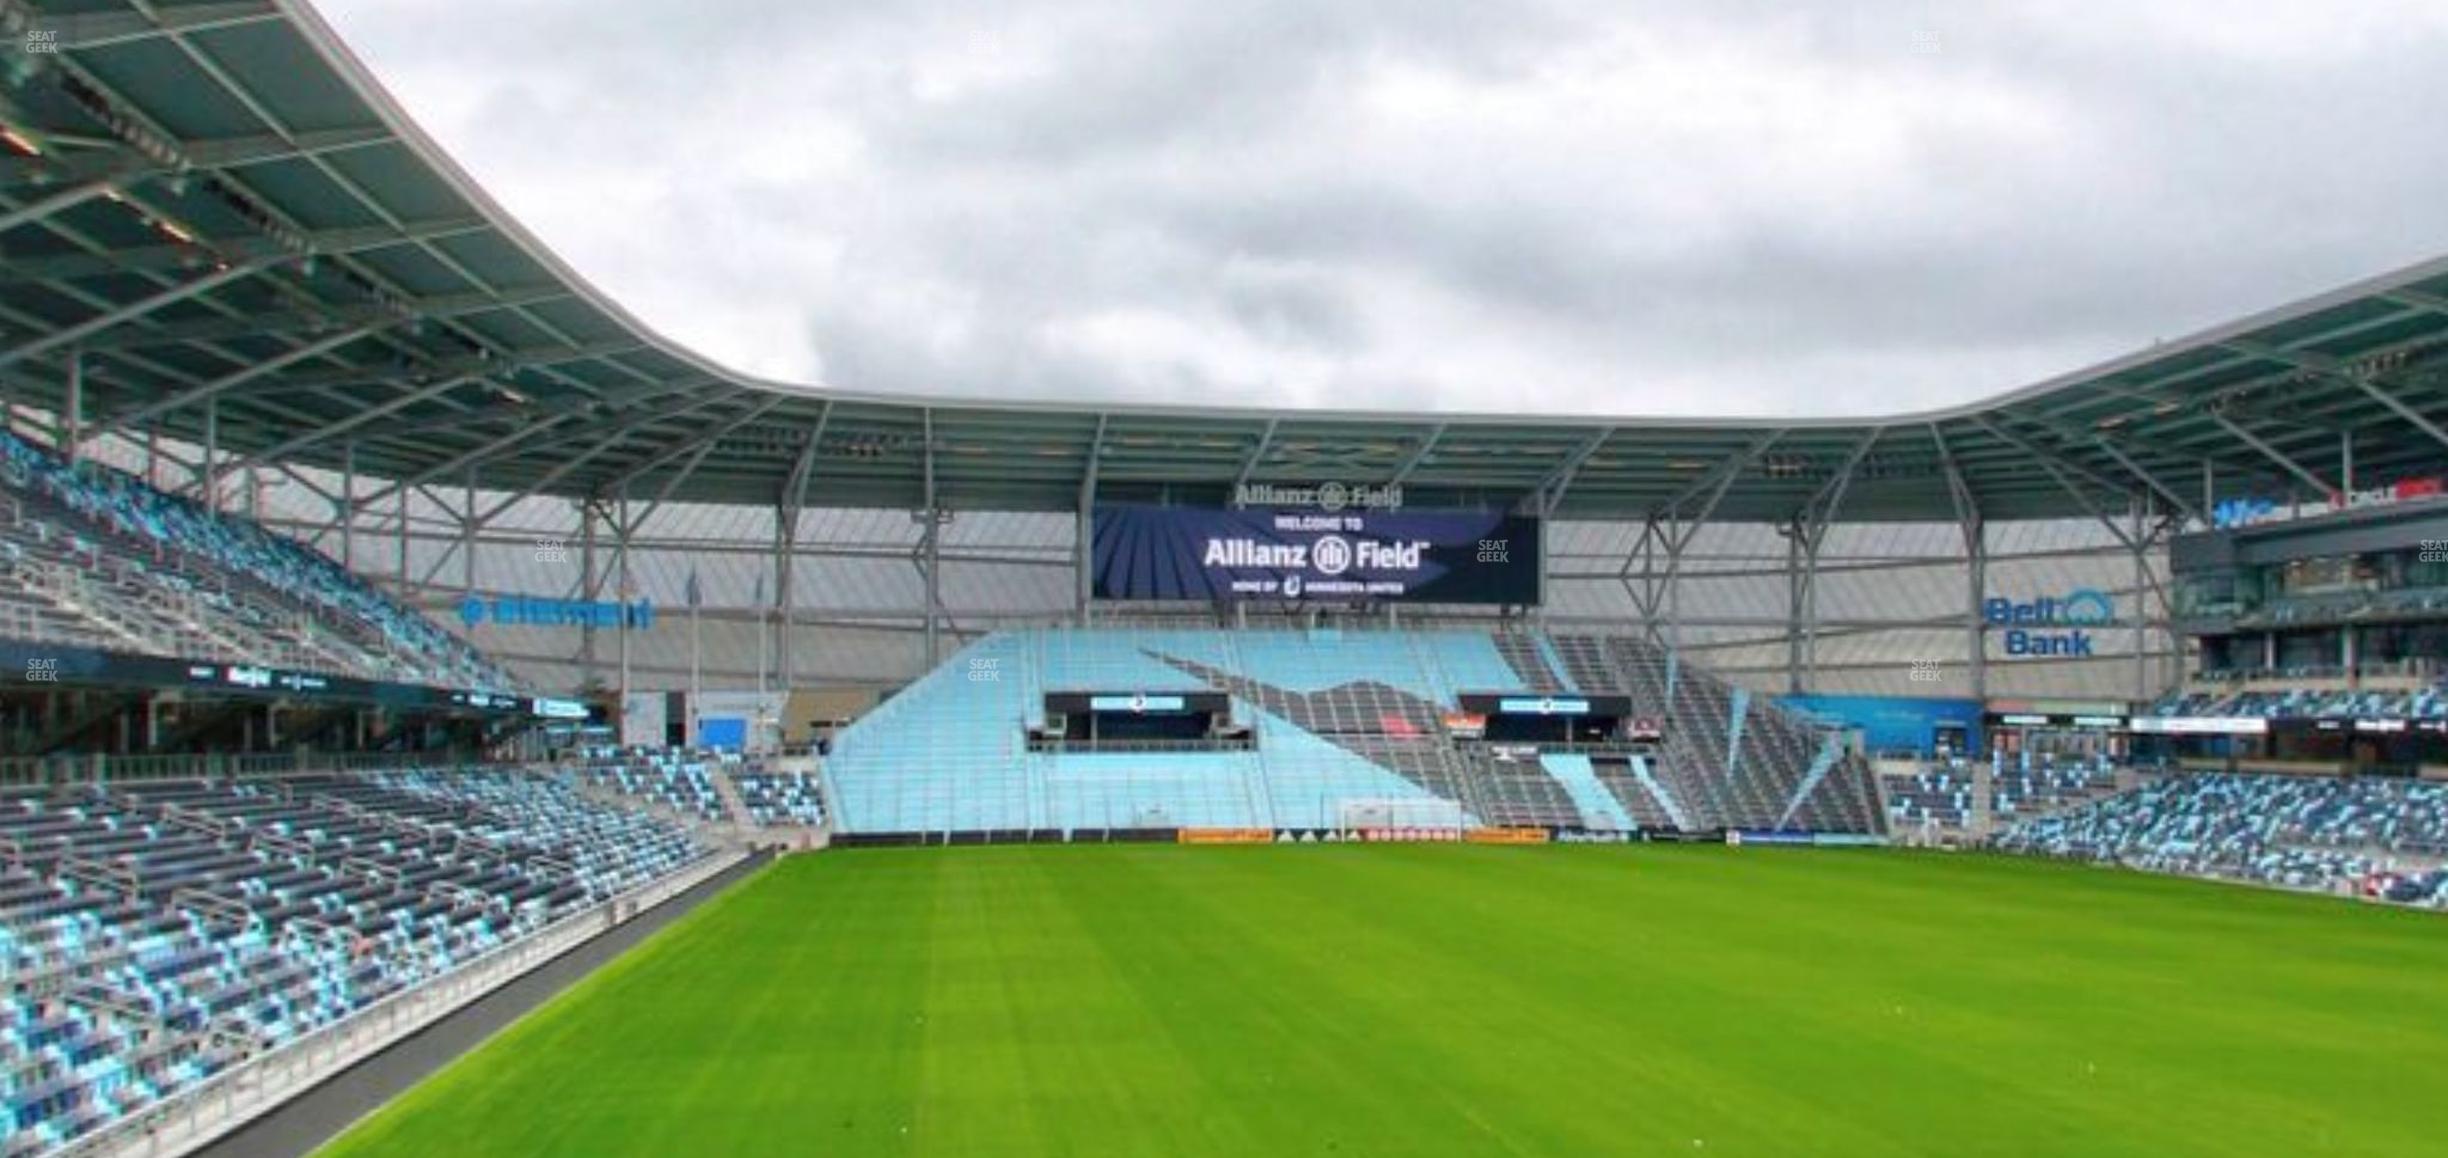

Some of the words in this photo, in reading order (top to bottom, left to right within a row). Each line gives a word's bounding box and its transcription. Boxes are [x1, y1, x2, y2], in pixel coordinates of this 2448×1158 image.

[1235, 483, 1313, 505] Allianz
[1353, 484, 1402, 507] Field
[1274, 515, 1342, 531] WELCOME
[1344, 516, 1364, 531] TO
[1204, 538, 1307, 568] Allianz
[1984, 598, 2053, 625] Bell
[2006, 630, 2092, 656] Bank
